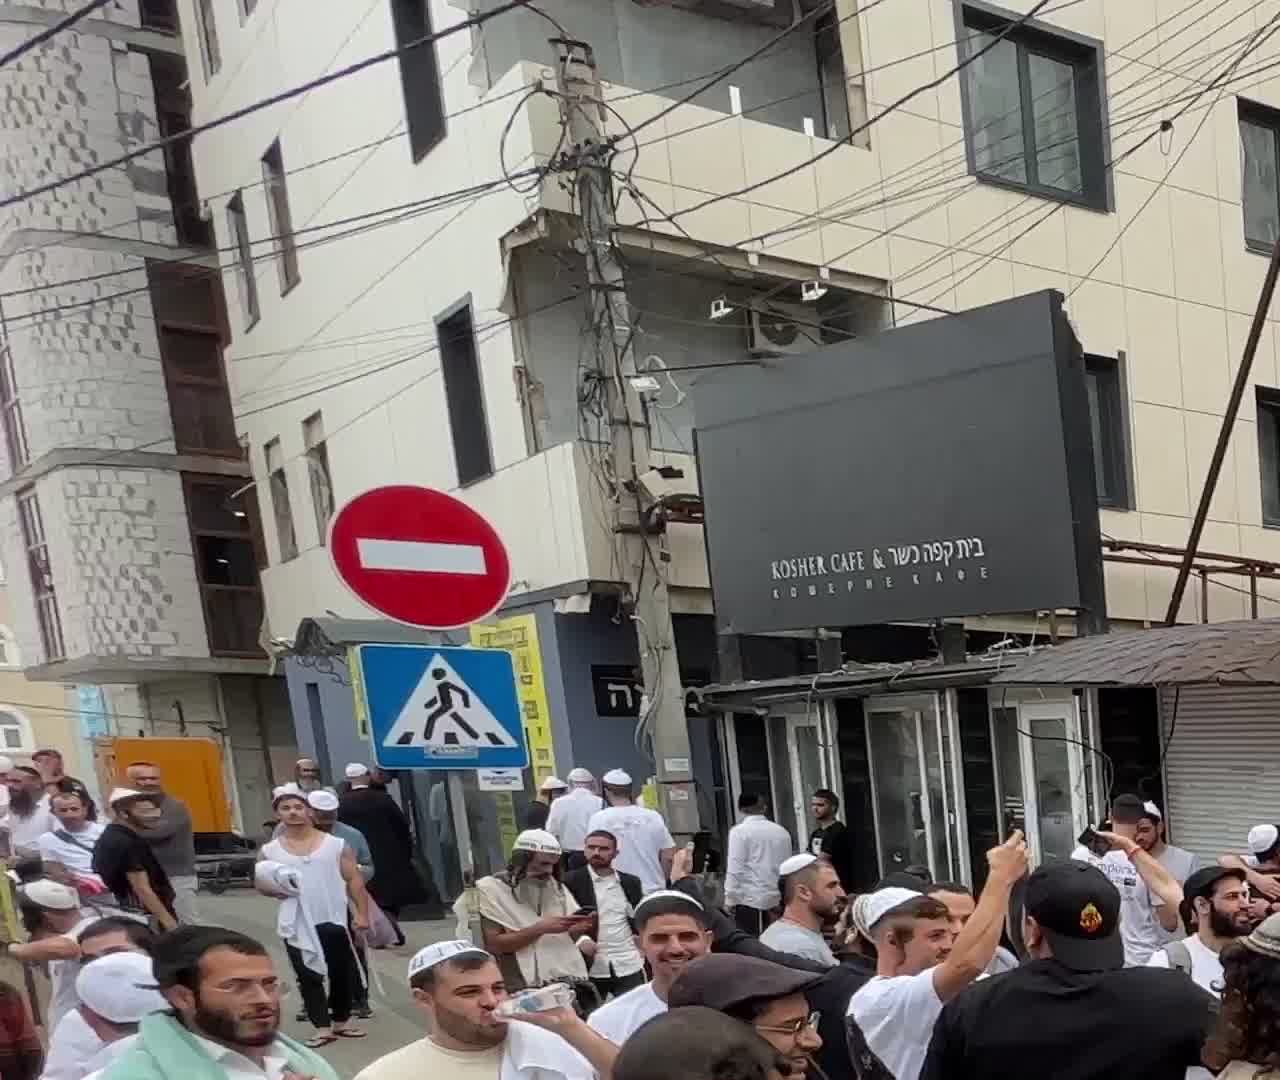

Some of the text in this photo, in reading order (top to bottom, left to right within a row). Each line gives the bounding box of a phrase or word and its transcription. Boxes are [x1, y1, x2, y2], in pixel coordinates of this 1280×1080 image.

[771, 549, 886, 580] KOSHER CAFE &
[887, 537, 985, 567] בית קפה כשר
